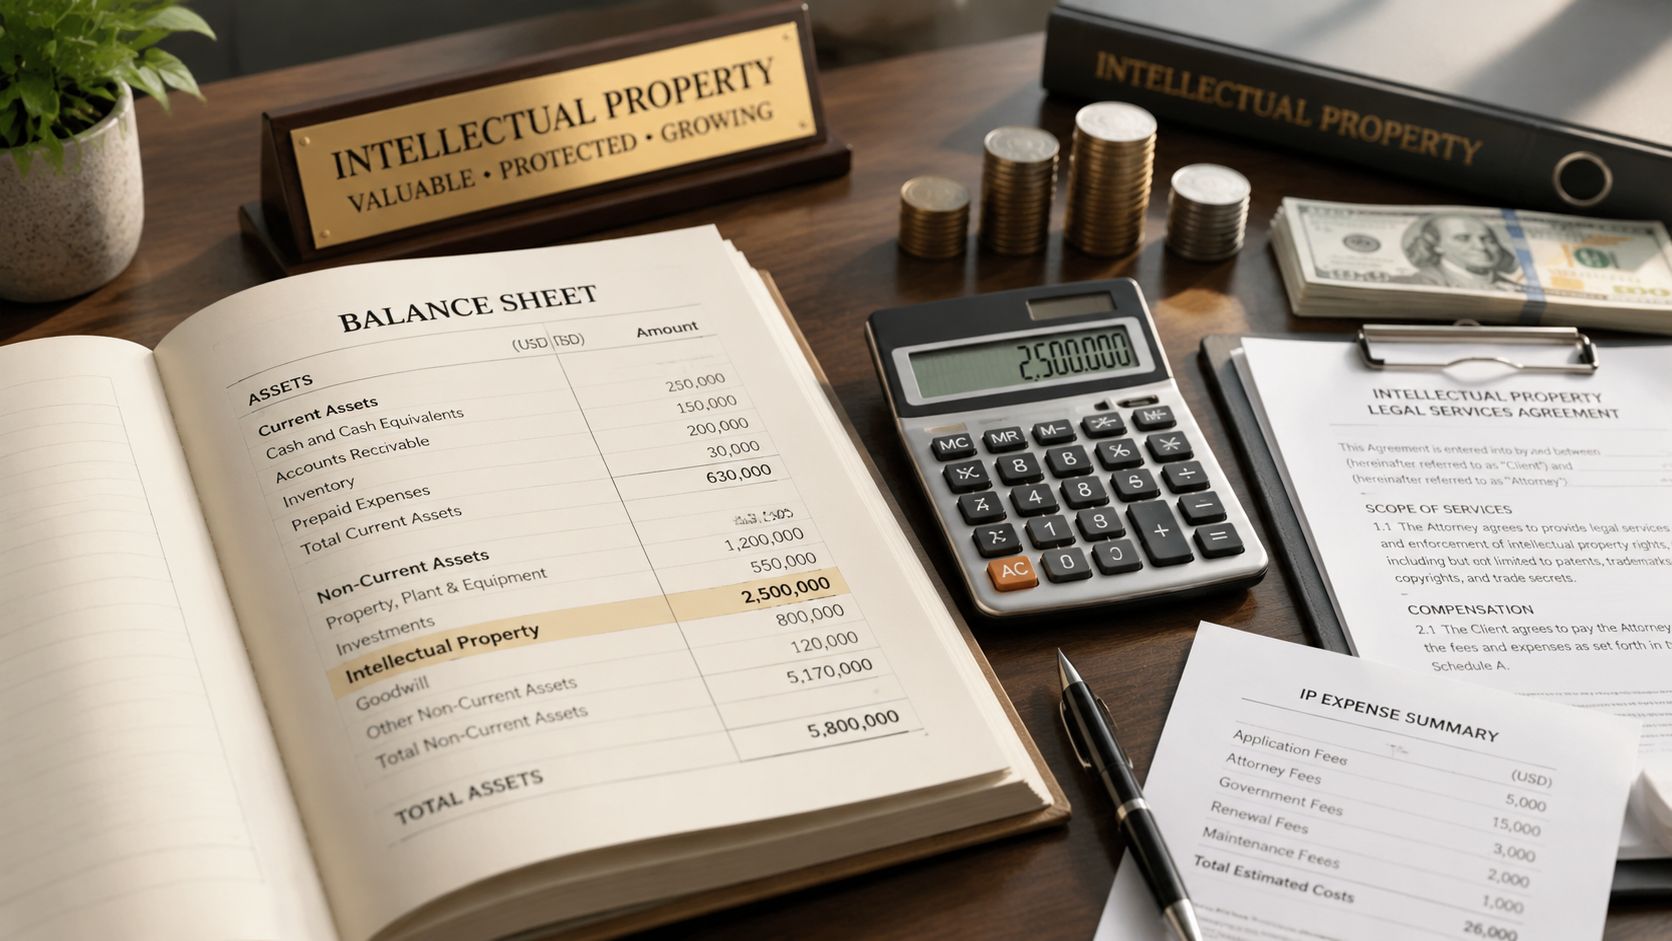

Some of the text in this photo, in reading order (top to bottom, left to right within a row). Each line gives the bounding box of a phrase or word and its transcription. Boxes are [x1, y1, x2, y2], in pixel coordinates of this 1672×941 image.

[331, 56, 775, 181] INTELLECTUAL PROPERTY
[1095, 50, 1483, 166] INTELLECTUAL PROPERTY
[348, 101, 774, 214] VALUABLE PROTECTED GROWING
[338, 285, 597, 333] BALANCE SHEET
[636, 320, 699, 338] Amount
[248, 374, 313, 406] ASSETS
[1367, 405, 1620, 419] LEGAL SERVICES AGREEMENT
[1372, 388, 1603, 404] INTELLECTUAL PROPERTY
[258, 396, 378, 437] Current Assets
[266, 372, 726, 460] Cash and Cash Equivalents 250,000
[275, 394, 737, 484] Accounts 150,000
[939, 431, 1020, 451] MC MR
[283, 417, 749, 508] Inventory 200,000
[1338, 442, 1600, 457] This Agreement is entered into by between
[1346, 458, 1416, 469] (hereinafter
[1419, 460, 1467, 469] referred
[1470, 461, 1482, 470] to
[1551, 462, 1573, 471] and
[292, 440, 760, 532] Prepaid Expenses 30,000
[1029, 482, 1092, 504] 4 8
[1352, 474, 1422, 485] (hereinafter
[1425, 475, 1472, 485] referred
[1475, 476, 1487, 486] to
[1490, 478, 1503, 486] as
[300, 463, 772, 556] Total Current Assets 630,000
[1044, 522, 1056, 536] 1
[1365, 504, 1513, 515] SCOPE OF SERVICES
[1373, 522, 1671, 535] 1.1 The Attorney agrees to provide legal services
[1002, 562, 1029, 578] AC
[1381, 539, 1670, 551] and enforcement of intellectual property rights,
[1386, 556, 1605, 568] including but limited to patents,
[317, 550, 490, 604] Non-Current Assets
[325, 527, 804, 630] Property, Plant & Equipment 1,200,000
[1395, 573, 1577, 584] copyrights, and trade secrets.
[335, 551, 817, 656] Investments 550,000
[1408, 605, 1535, 615] COMPENSATION
[345, 576, 831, 684] Intellectual Property 2,500,000
[1416, 624, 1671, 635] 2.1 The Client agrees to pay the Attorney
[1424, 643, 1446, 653] the
[1450, 642, 1478, 652] fees
[1482, 642, 1507, 652] and
[1511, 642, 1572, 654] expenses
[1575, 642, 1590, 651] as
[1593, 641, 1612, 651] set
[1615, 640, 1647, 650] forth
[1649, 640, 1663, 650] in
[355, 603, 845, 712] Goodwill 800,000
[1432, 661, 1510, 672] Schedule A.
[365, 630, 859, 741] Other Non-Current Assets 120,000
[375, 658, 873, 770] Total Non-Current Assets 5,170,000
[1300, 688, 1500, 743] IP EXPENSE SUMMARY
[394, 709, 900, 826] TOTAL ASSETS 5,800,000
[1225, 752, 1547, 812] Attorney Fees 5,000
[1233, 729, 1553, 789] Application (USD)
[1211, 800, 1536, 863] Renewal Fees 3,000
[1219, 776, 1542, 837] Government Fees 15,000
[1202, 826, 1531, 889] Maintenance 2,000
[1194, 854, 1525, 915] Total Estimated Costs 1,000
[1463, 920, 1518, 941] 26,000
